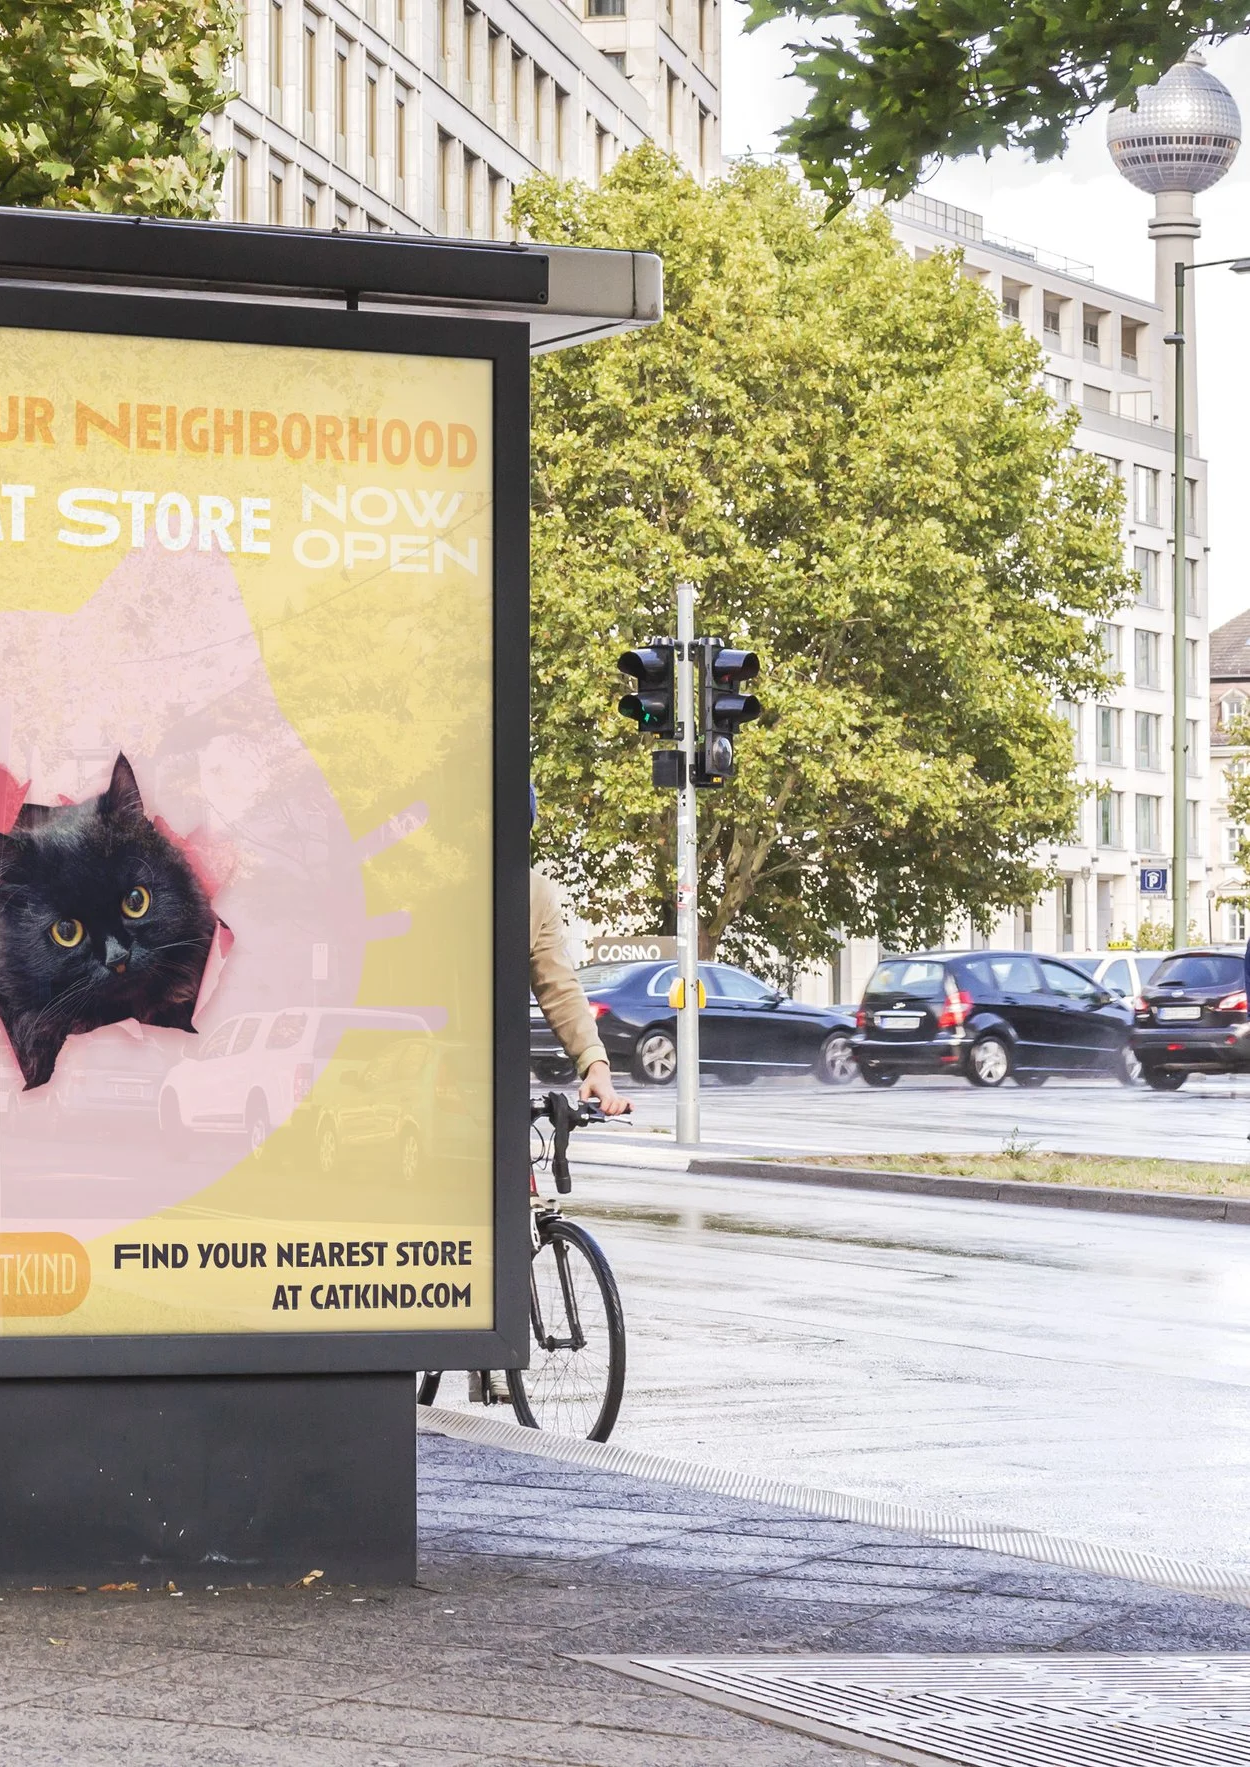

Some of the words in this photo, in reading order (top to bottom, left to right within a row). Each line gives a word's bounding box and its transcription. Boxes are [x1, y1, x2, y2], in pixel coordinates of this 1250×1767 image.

[75, 399, 478, 470] NEIGHBORHOOD
[57, 486, 271, 555] STORE
[301, 483, 464, 529] NOW
[292, 528, 479, 577] OPEN
[597, 944, 661, 961] COSMO
[114, 1242, 189, 1270] FIND
[196, 1242, 268, 1269] YOUR
[276, 1241, 389, 1268] NEAREST
[395, 1240, 472, 1267] STORE
[271, 1284, 302, 1310] AT
[310, 1282, 471, 1310] CATKIND.COM
